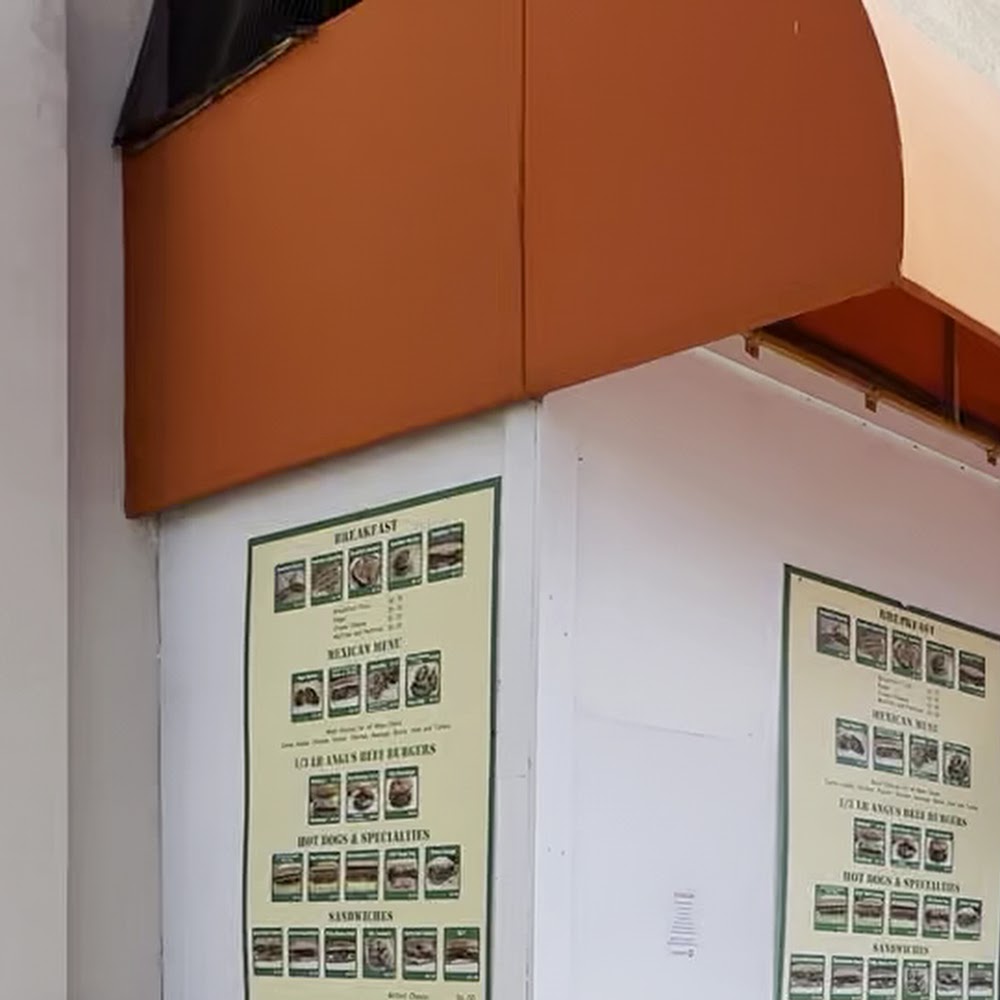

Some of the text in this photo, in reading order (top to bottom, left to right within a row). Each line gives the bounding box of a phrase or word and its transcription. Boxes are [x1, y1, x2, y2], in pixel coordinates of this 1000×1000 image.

[334, 518, 398, 546] BREAKFAST
[327, 644, 370, 660] MEXICAN
[387, 743, 437, 760] BURGERS
[298, 835, 319, 848] HOT
[322, 833, 349, 847] DOGS
[843, 870, 864, 883] HOT
[866, 873, 892, 886] DOGS
[328, 910, 394, 922] SANDWICHES
